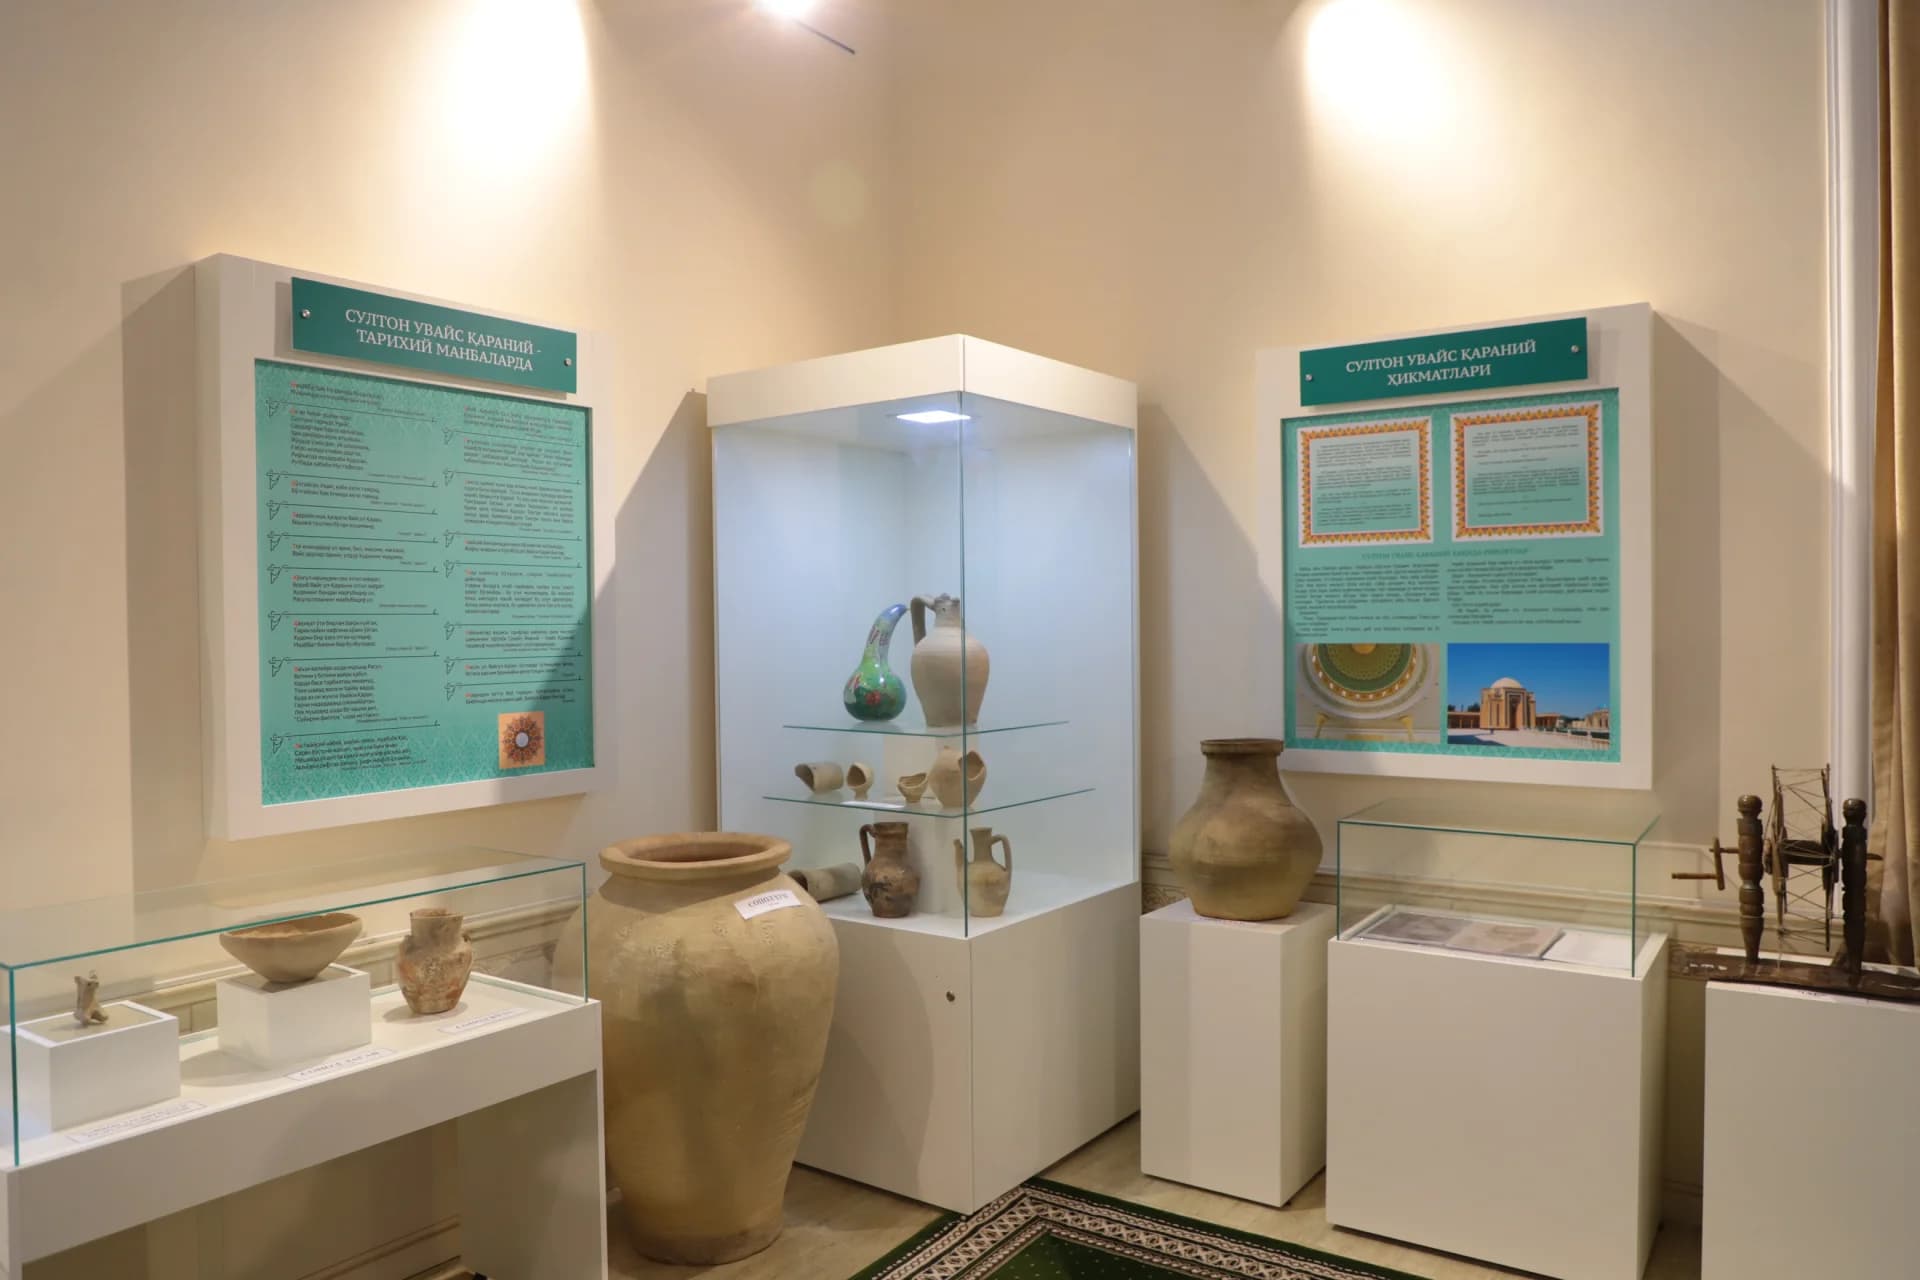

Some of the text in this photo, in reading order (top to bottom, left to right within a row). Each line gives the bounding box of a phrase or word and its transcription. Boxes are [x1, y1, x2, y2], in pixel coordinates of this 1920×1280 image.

[345, 308, 411, 333] СУЛТОН
[414, 320, 465, 342] УВАЙС
[356, 328, 534, 372] ТАРИХИЙ МАНБАЛАРДА
[1345, 356, 1404, 373] СУЛТОН
[1407, 349, 1457, 367] УВАЙС
[1387, 364, 1492, 387] ҲИКМАТЛАРИ
